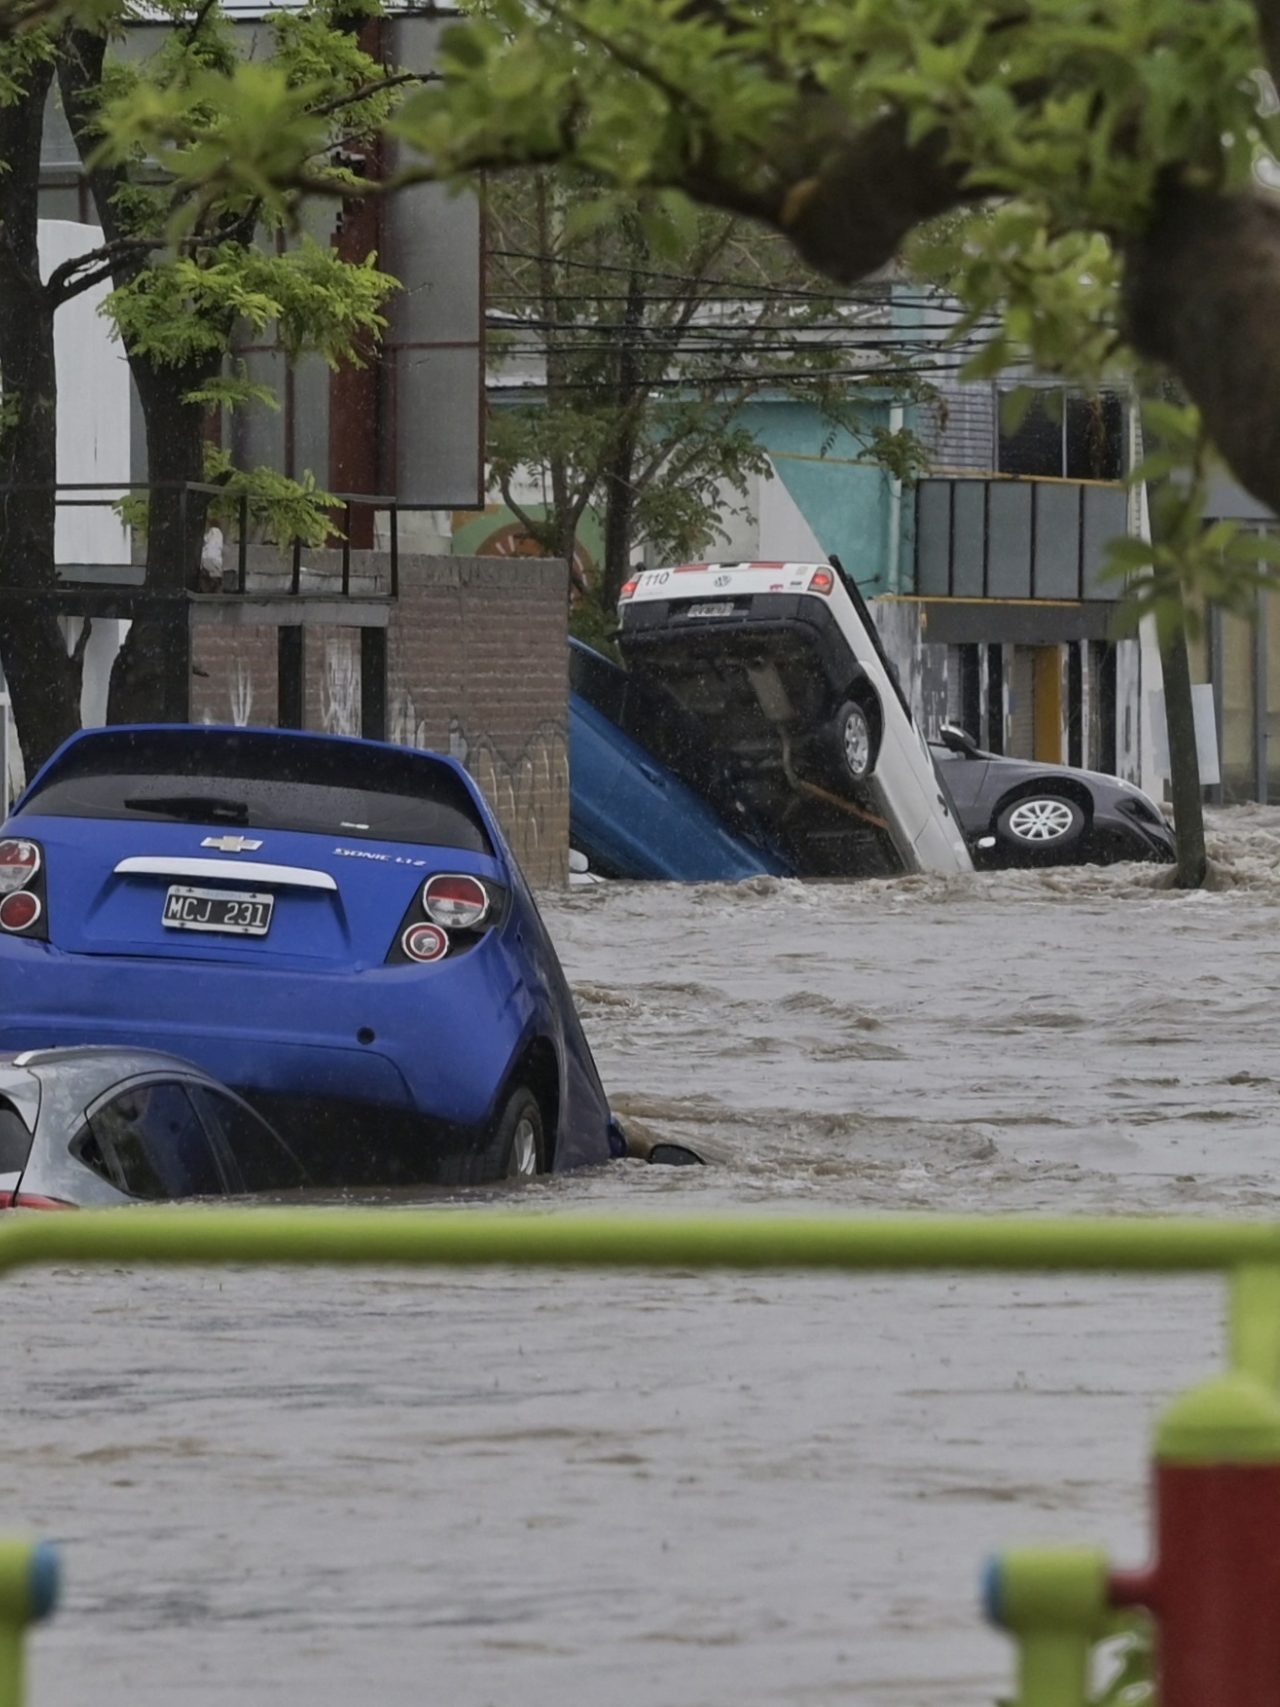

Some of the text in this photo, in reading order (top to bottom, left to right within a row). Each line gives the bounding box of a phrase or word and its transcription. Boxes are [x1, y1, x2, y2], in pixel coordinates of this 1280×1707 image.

[645, 571, 670, 587] 110
[167, 896, 264, 927] MCJ 231
